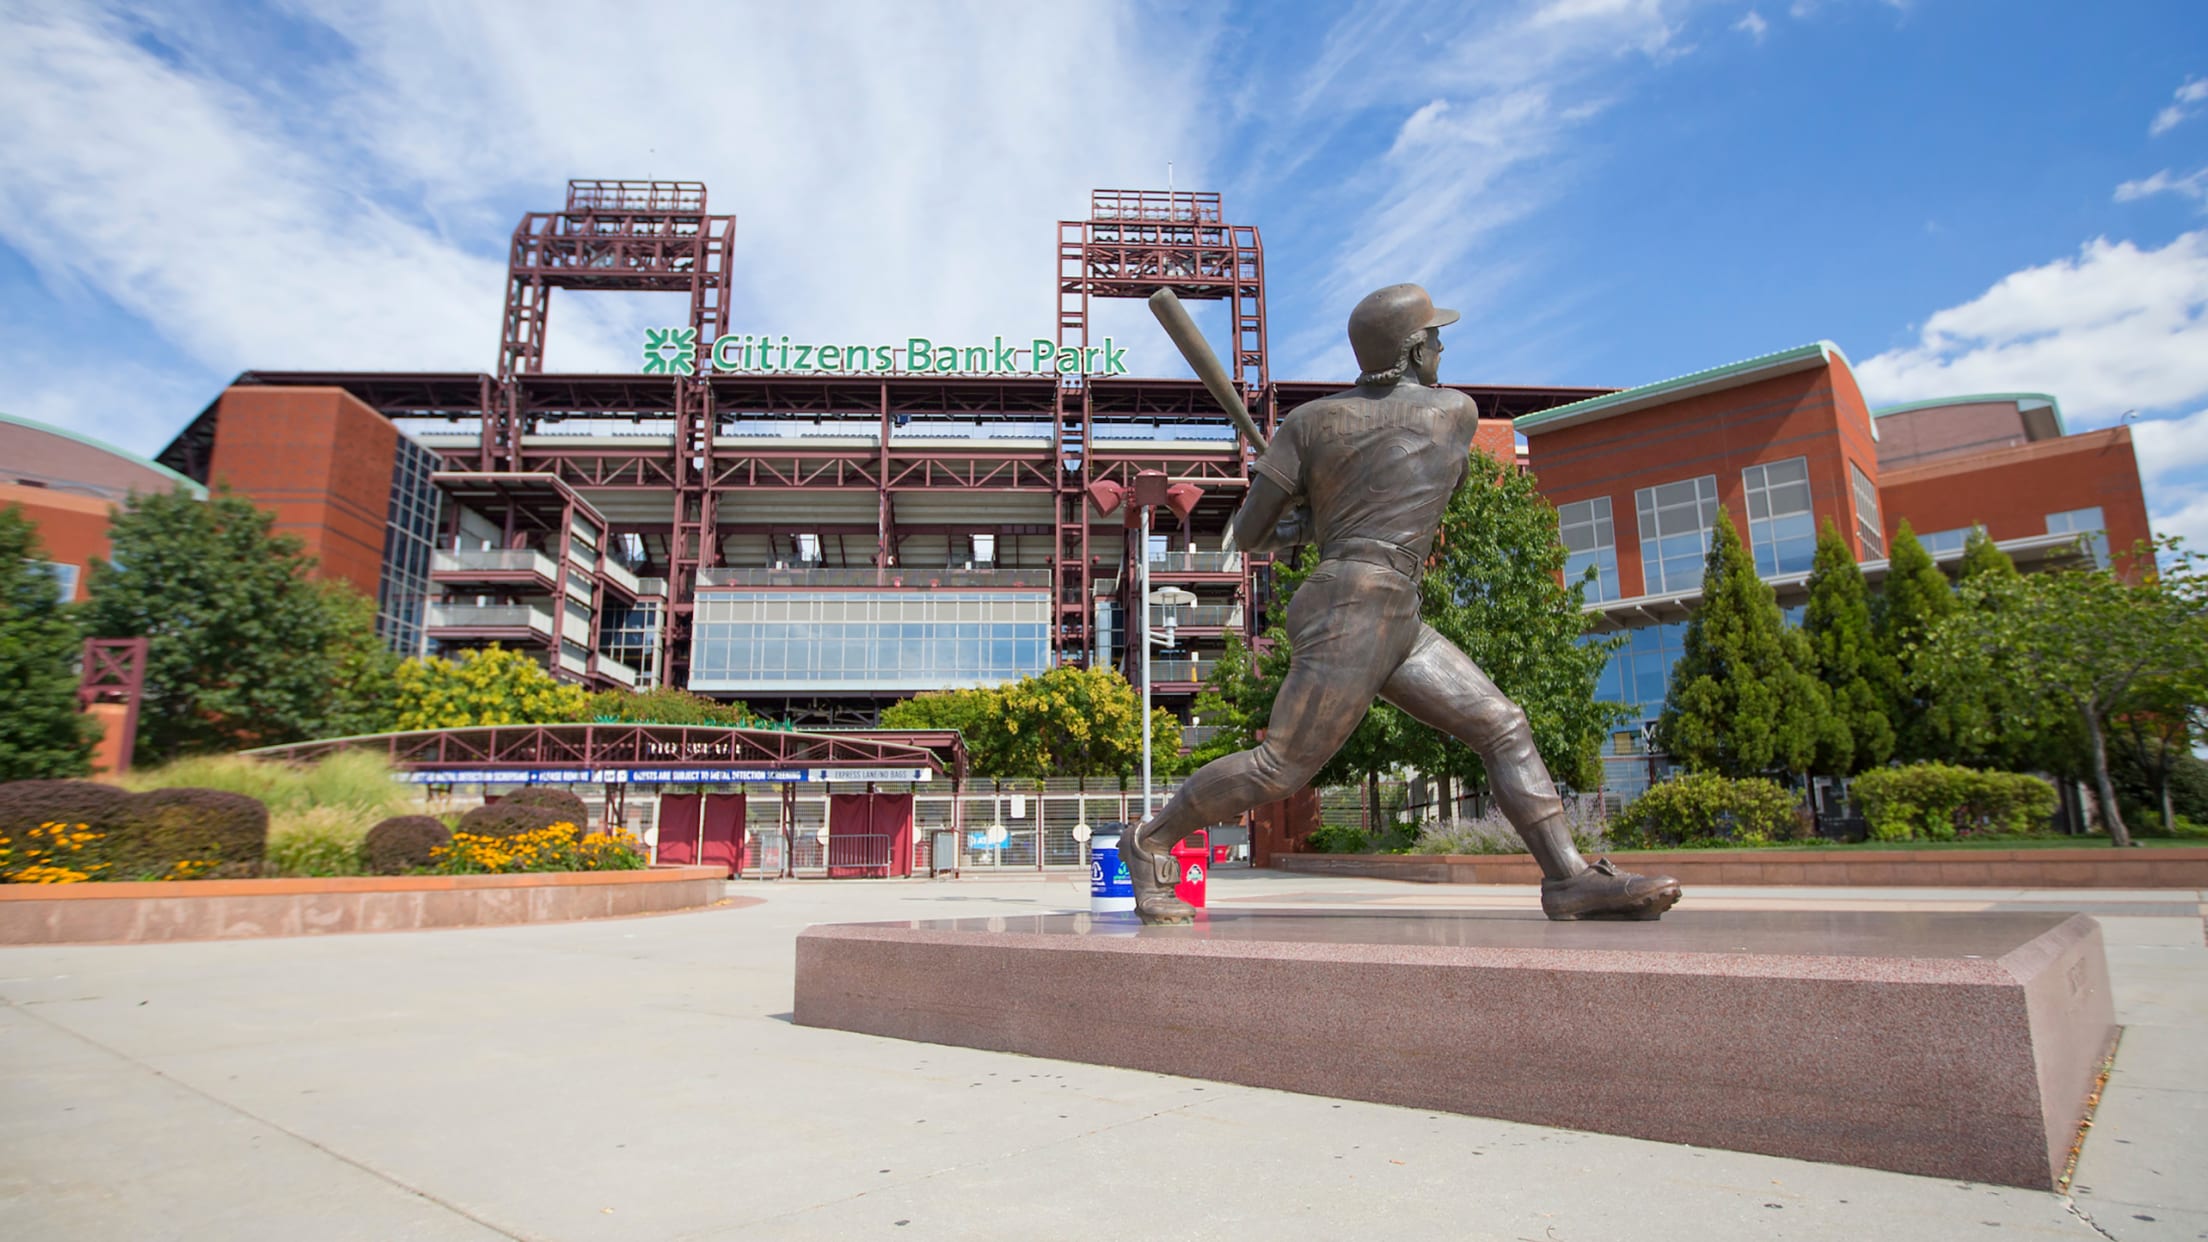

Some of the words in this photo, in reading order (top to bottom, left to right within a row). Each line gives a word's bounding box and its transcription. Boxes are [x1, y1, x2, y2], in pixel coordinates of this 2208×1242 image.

[711, 334, 894, 372] Citizens
[905, 335, 1016, 373] Bank
[1031, 337, 1130, 375] Park
[633, 770, 657, 781] GUESTS
[658, 770, 671, 781] ARE
[672, 770, 700, 781] SUBJECT
[710, 770, 731, 781] METAL
[732, 770, 765, 781] DETECTION
[767, 770, 801, 780] SCREENING
[835, 770, 860, 780] EXPRESS
